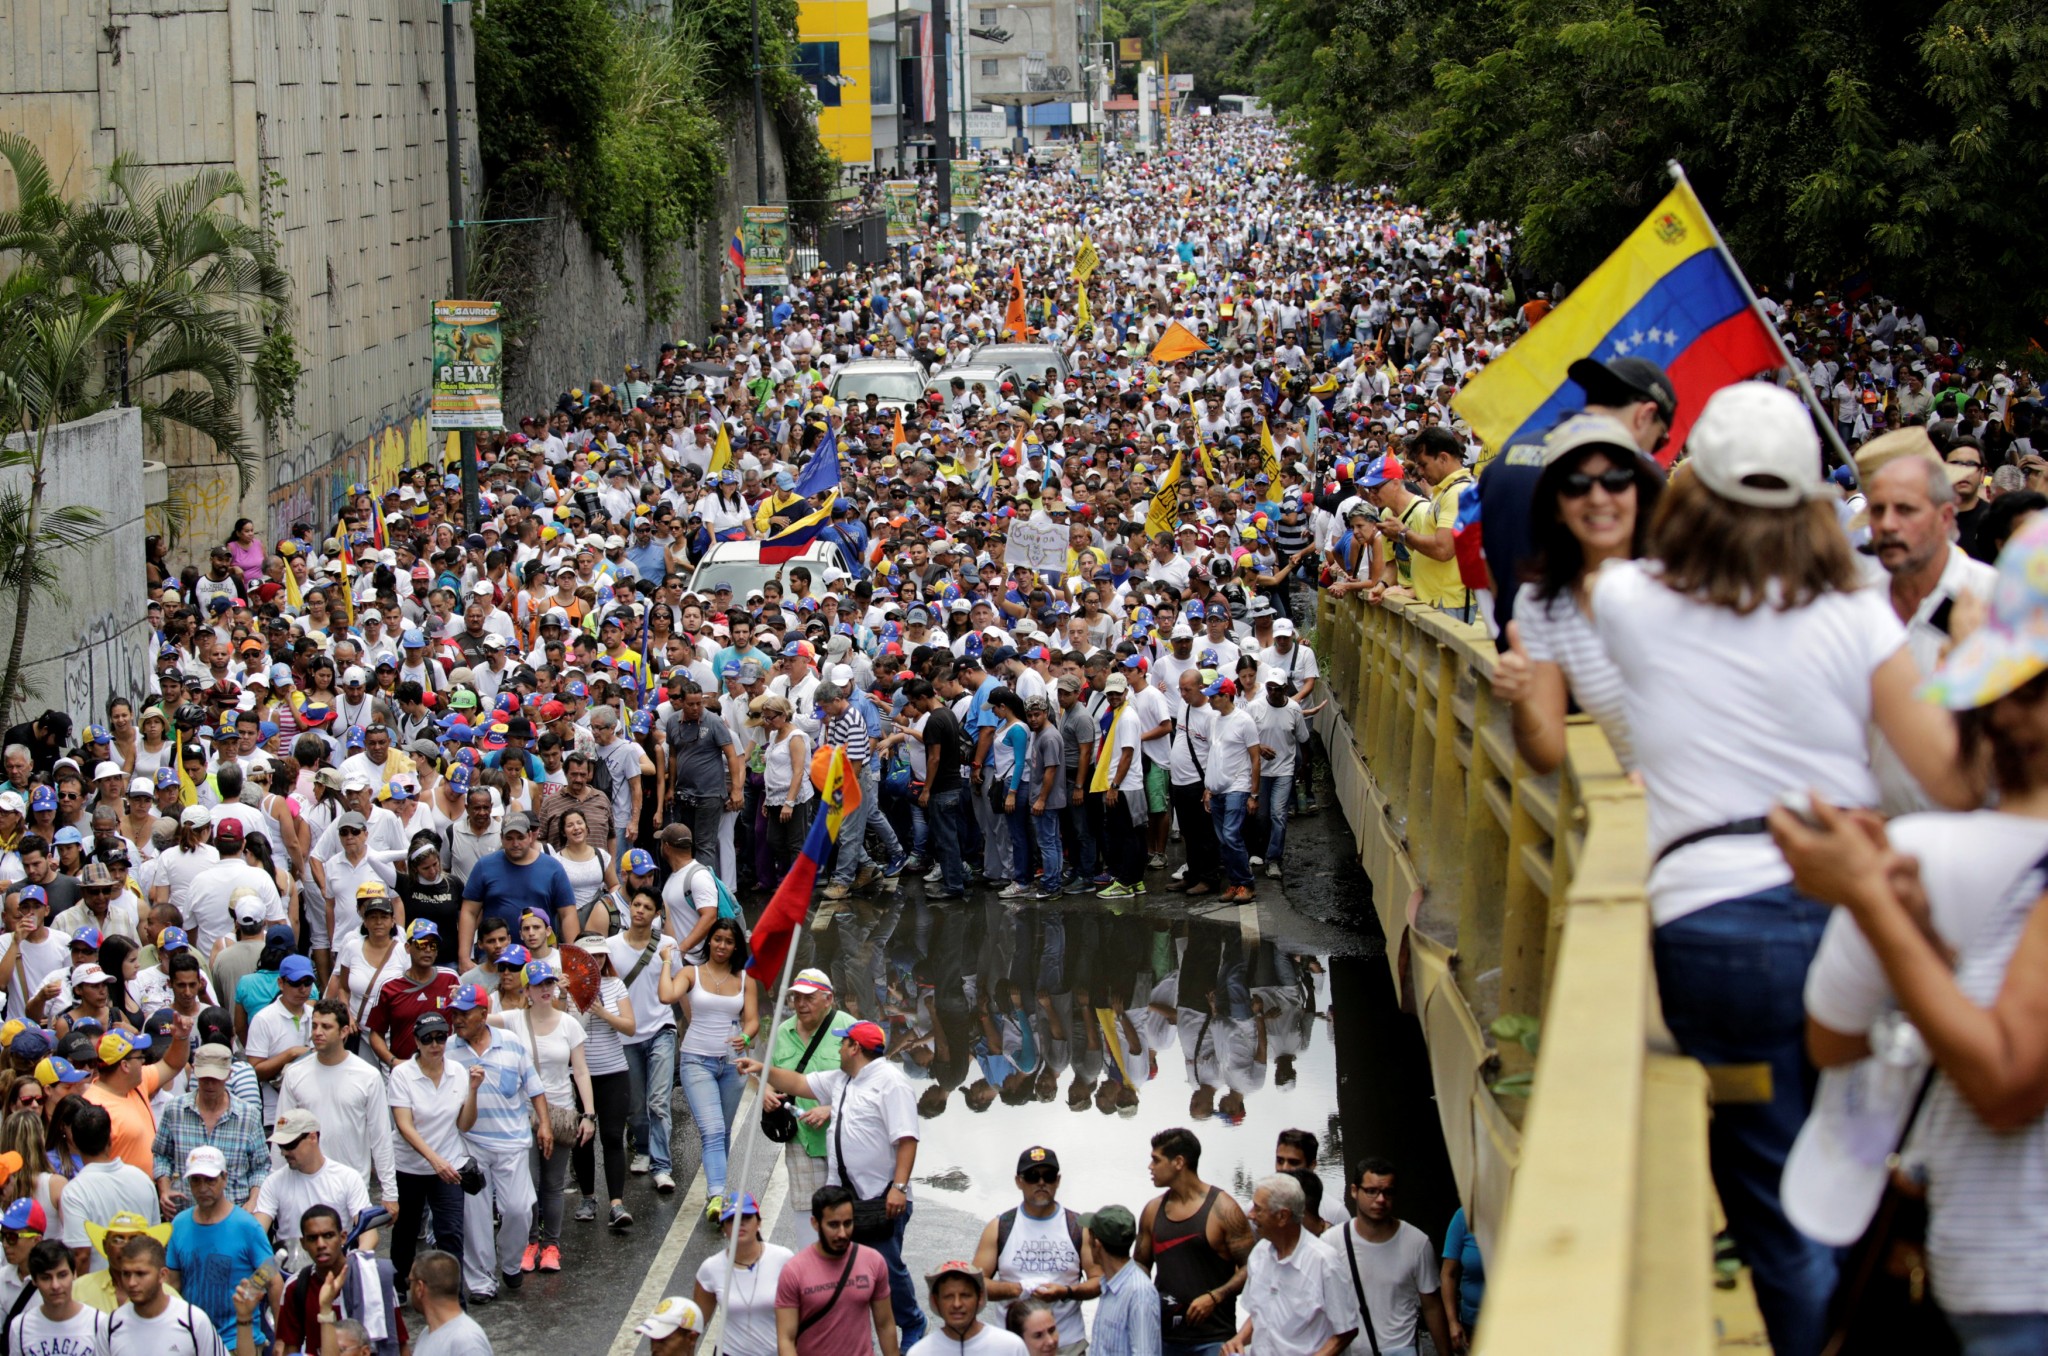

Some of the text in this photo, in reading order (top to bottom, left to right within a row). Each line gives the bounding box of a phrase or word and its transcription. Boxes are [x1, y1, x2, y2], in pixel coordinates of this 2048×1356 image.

[750, 247, 781, 258] REXY
[440, 365, 492, 382] REXY
[1021, 1240, 1068, 1252] ADIDAS
[1013, 1250, 1075, 1262] ADIDAS
[1020, 1260, 1069, 1272] ADIDAS
